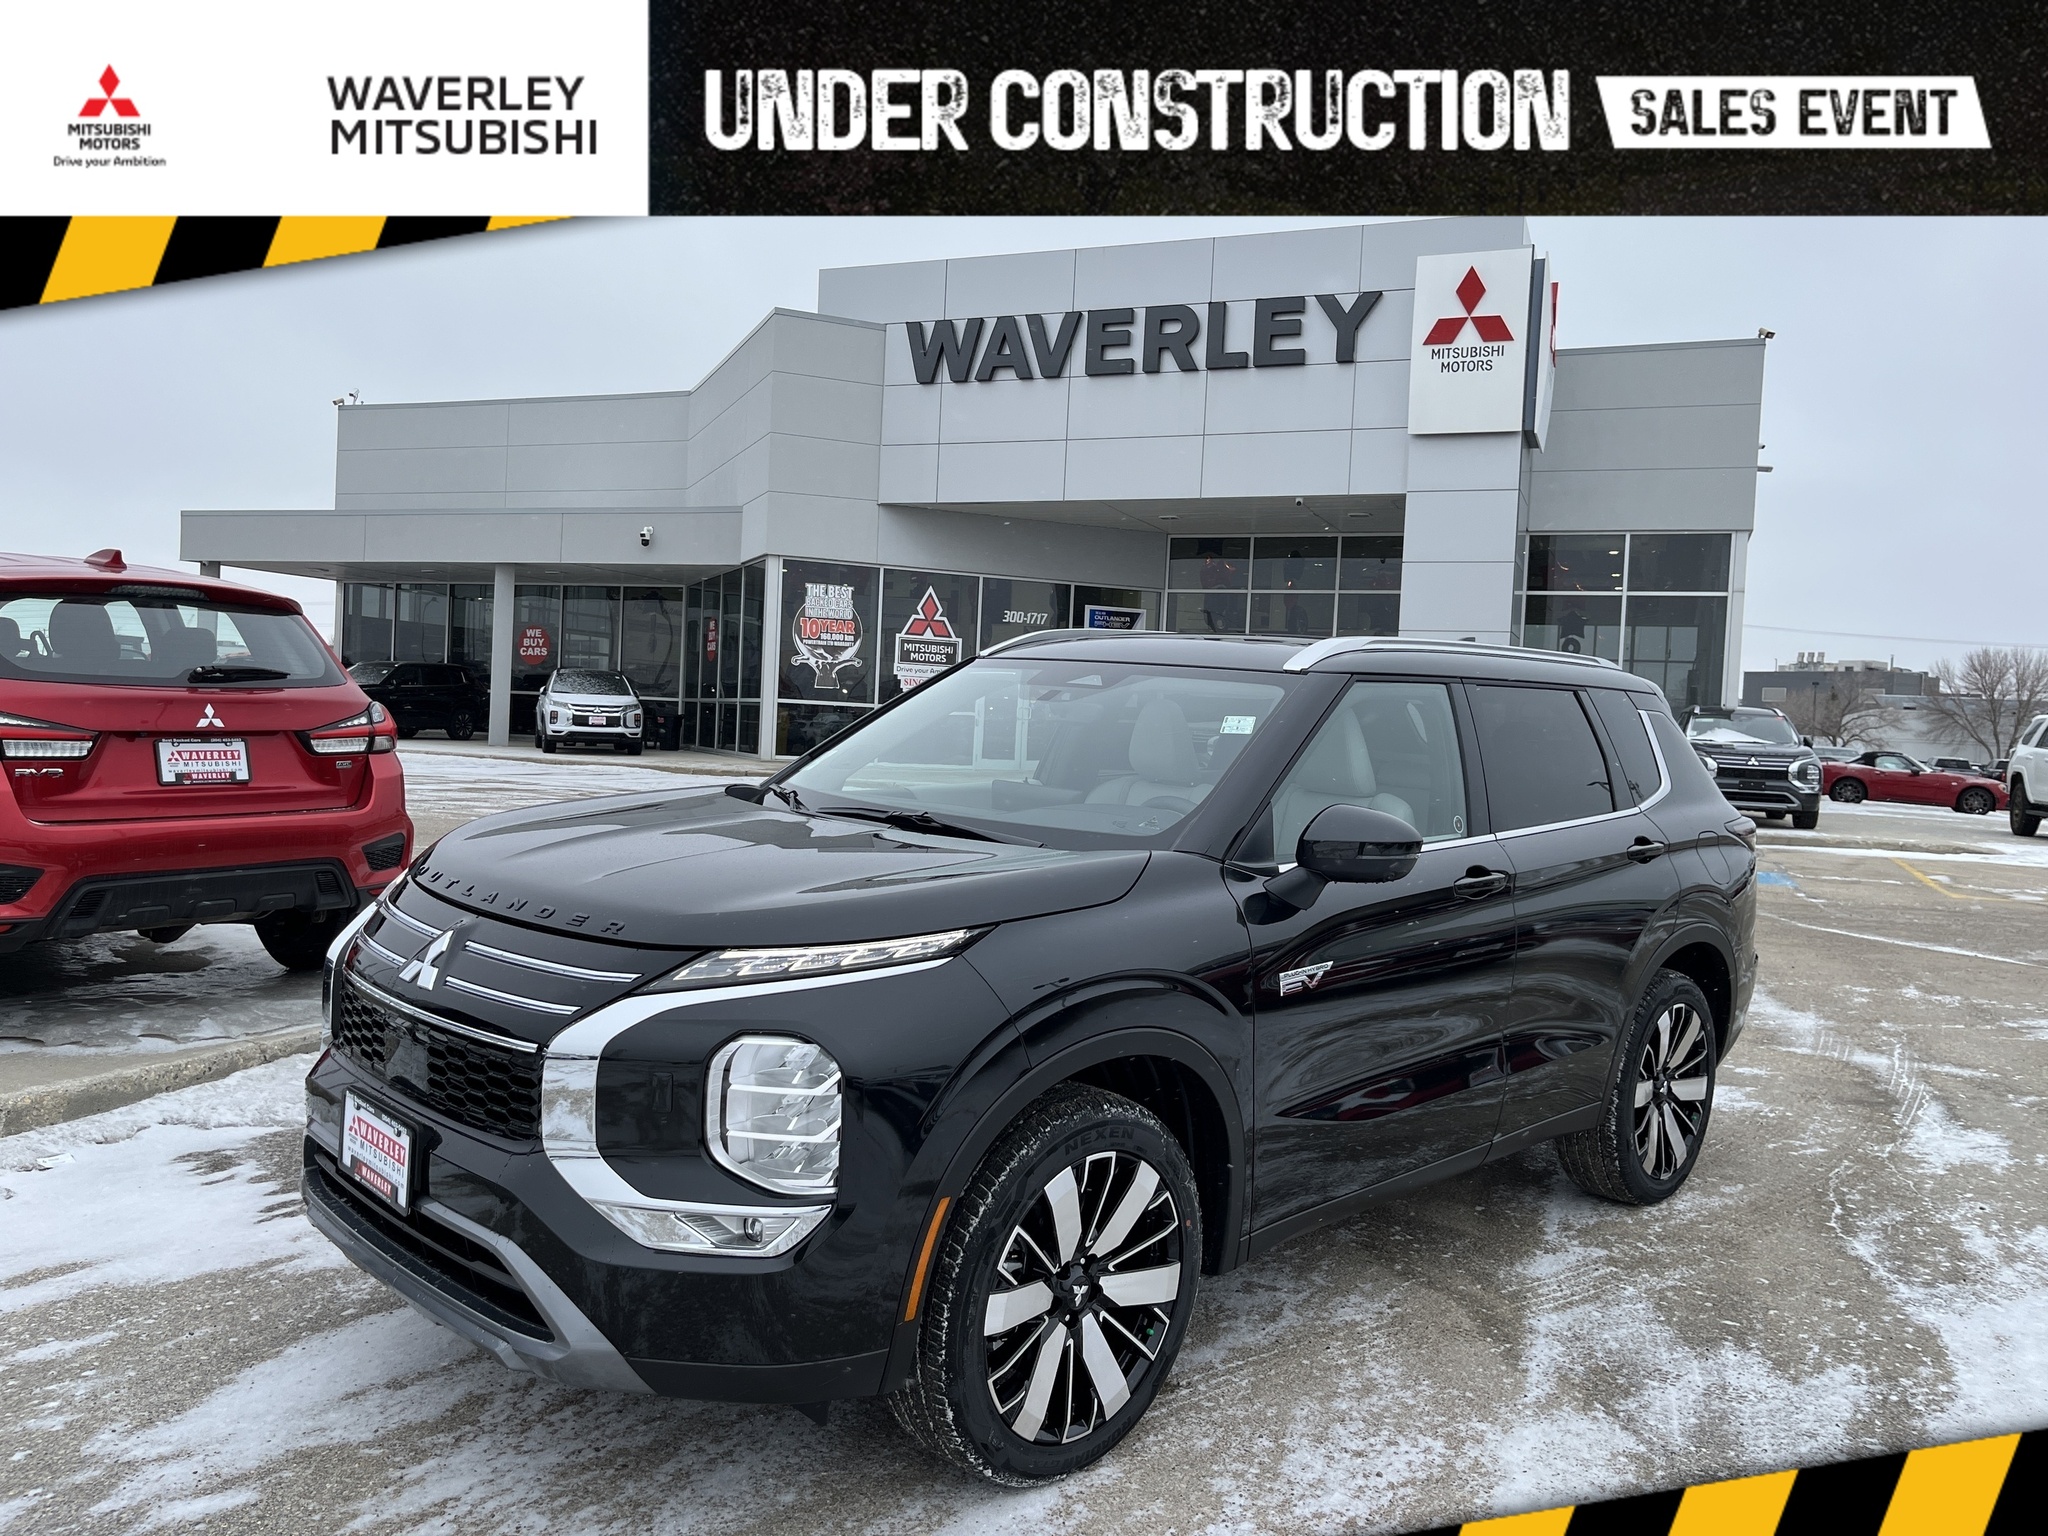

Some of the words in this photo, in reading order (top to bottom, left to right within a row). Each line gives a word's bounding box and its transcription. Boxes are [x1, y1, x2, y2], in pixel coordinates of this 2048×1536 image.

[905, 290, 1383, 384] WAVERLEY
[1431, 345, 1505, 360] MITSUBISHI
[1440, 359, 1493, 373] MOTORS
[805, 583, 827, 598] THE
[828, 584, 855, 600] BEST
[805, 596, 833, 608] BACKED
[834, 598, 854, 609] CARS
[829, 609, 854, 620] WORLD
[1002, 609, 1049, 625] 300-1717
[1094, 614, 1131, 623] OUTLANDER
[526, 629, 542, 637] WE
[800, 617, 820, 639] 10
[820, 618, 856, 635] YEAR
[523, 638, 545, 647] BUY
[903, 643, 954, 655] MITSUBISHI
[519, 647, 548, 656] CARS
[910, 652, 947, 663] MOTORS
[896, 665, 914, 674] Drive
[181, 751, 239, 760] WAVERLEY
[183, 760, 242, 768] MITSUBISHI
[14, 768, 64, 778] RVR
[191, 772, 231, 780] WAVERLEY
[416, 865, 626, 936] OUTLANDER
[1280, 971, 1324, 997] EV
[360, 1121, 406, 1166] WAVERLEY
[1064, 1126, 1135, 1156] NEXEN
[360, 1140, 405, 1179] MITSUBISHI
[361, 1165, 392, 1197] WAVERLEY
